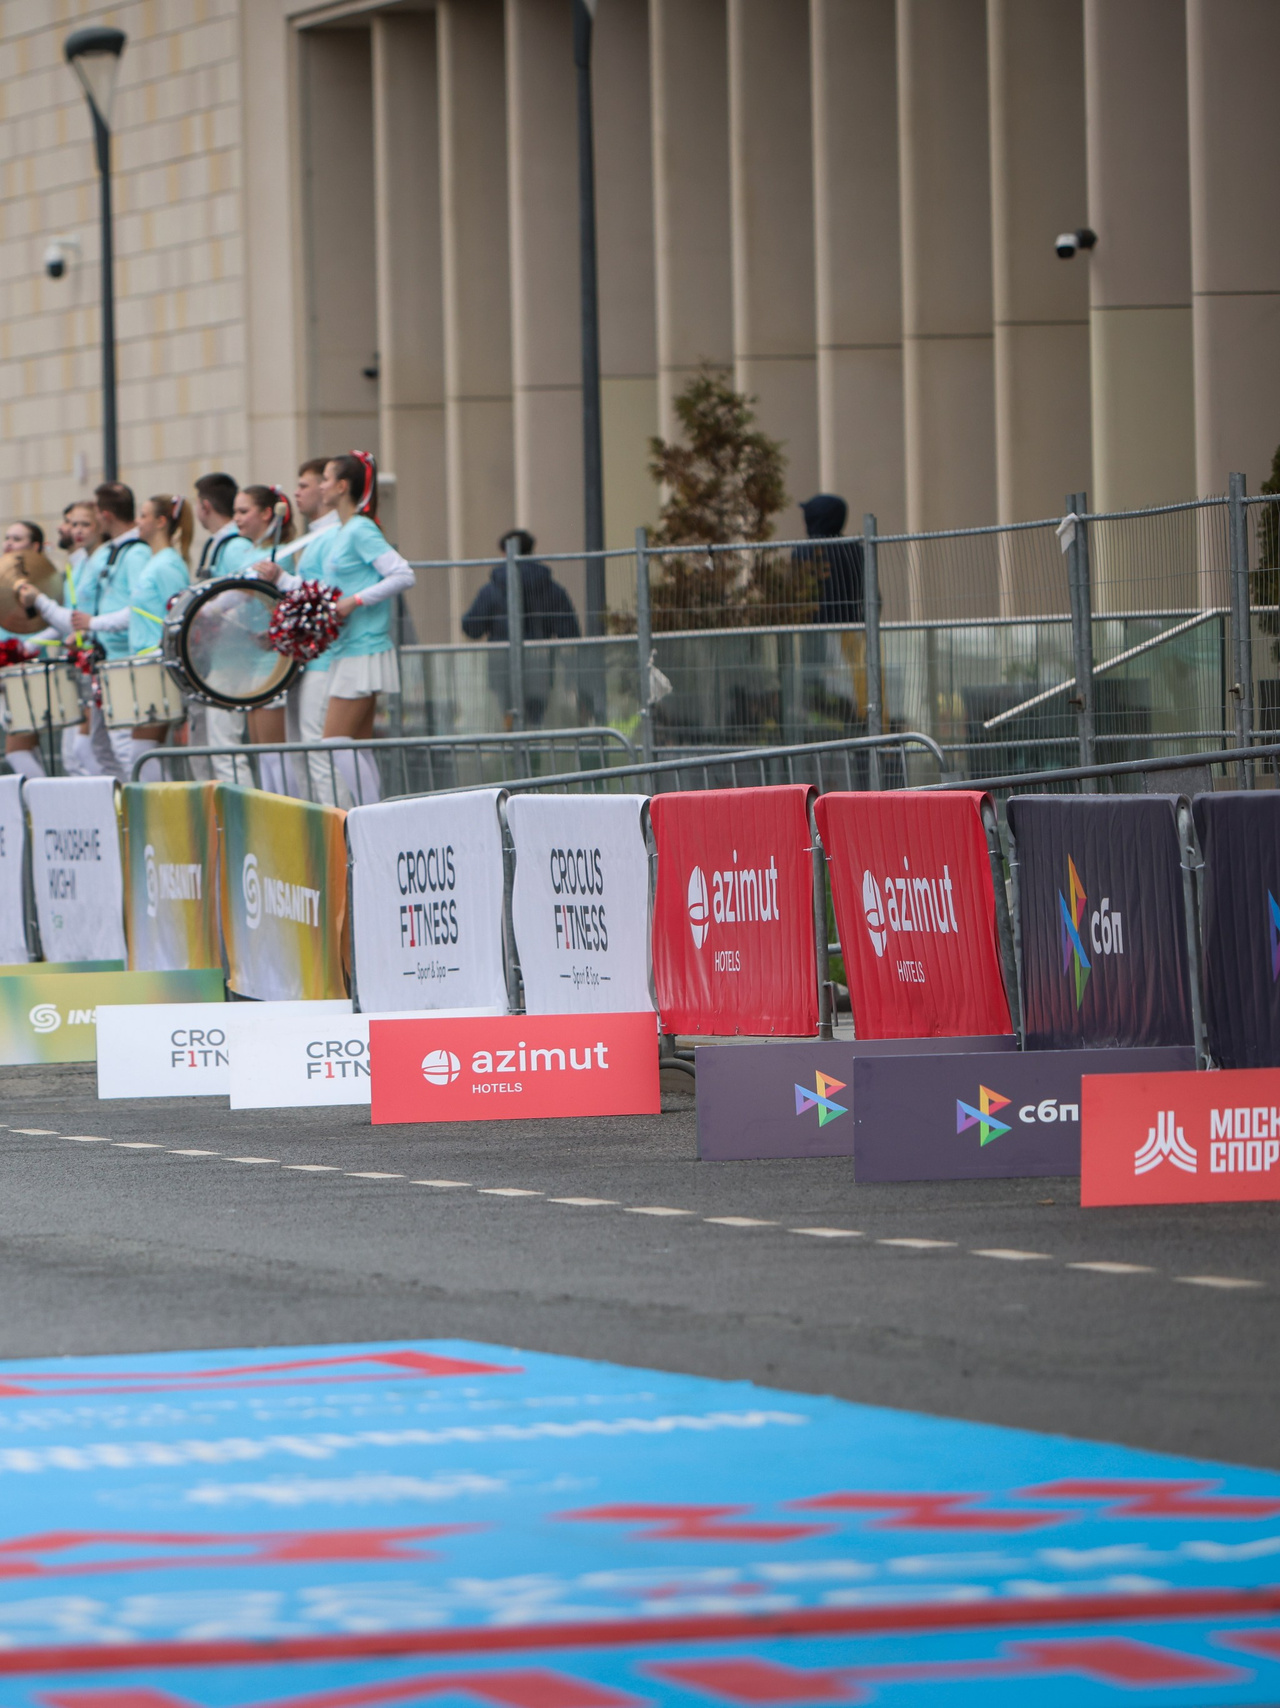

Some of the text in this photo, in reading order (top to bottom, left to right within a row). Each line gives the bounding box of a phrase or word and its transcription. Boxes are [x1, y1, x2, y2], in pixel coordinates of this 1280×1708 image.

[158, 863, 202, 899] INSANITY
[396, 845, 456, 896] CROCUS
[550, 848, 603, 896] CROCUS
[712, 849, 780, 924] azimut
[263, 876, 320, 927] INSANITY
[884, 855, 959, 934] azimut
[1091, 897, 1124, 956] сбп
[715, 951, 741, 972] HOTELS
[897, 960, 926, 983] HOTELS
[471, 1041, 609, 1073] azimut
[472, 1082, 523, 1094] HOTELS
[1018, 1099, 1079, 1123] сбп
